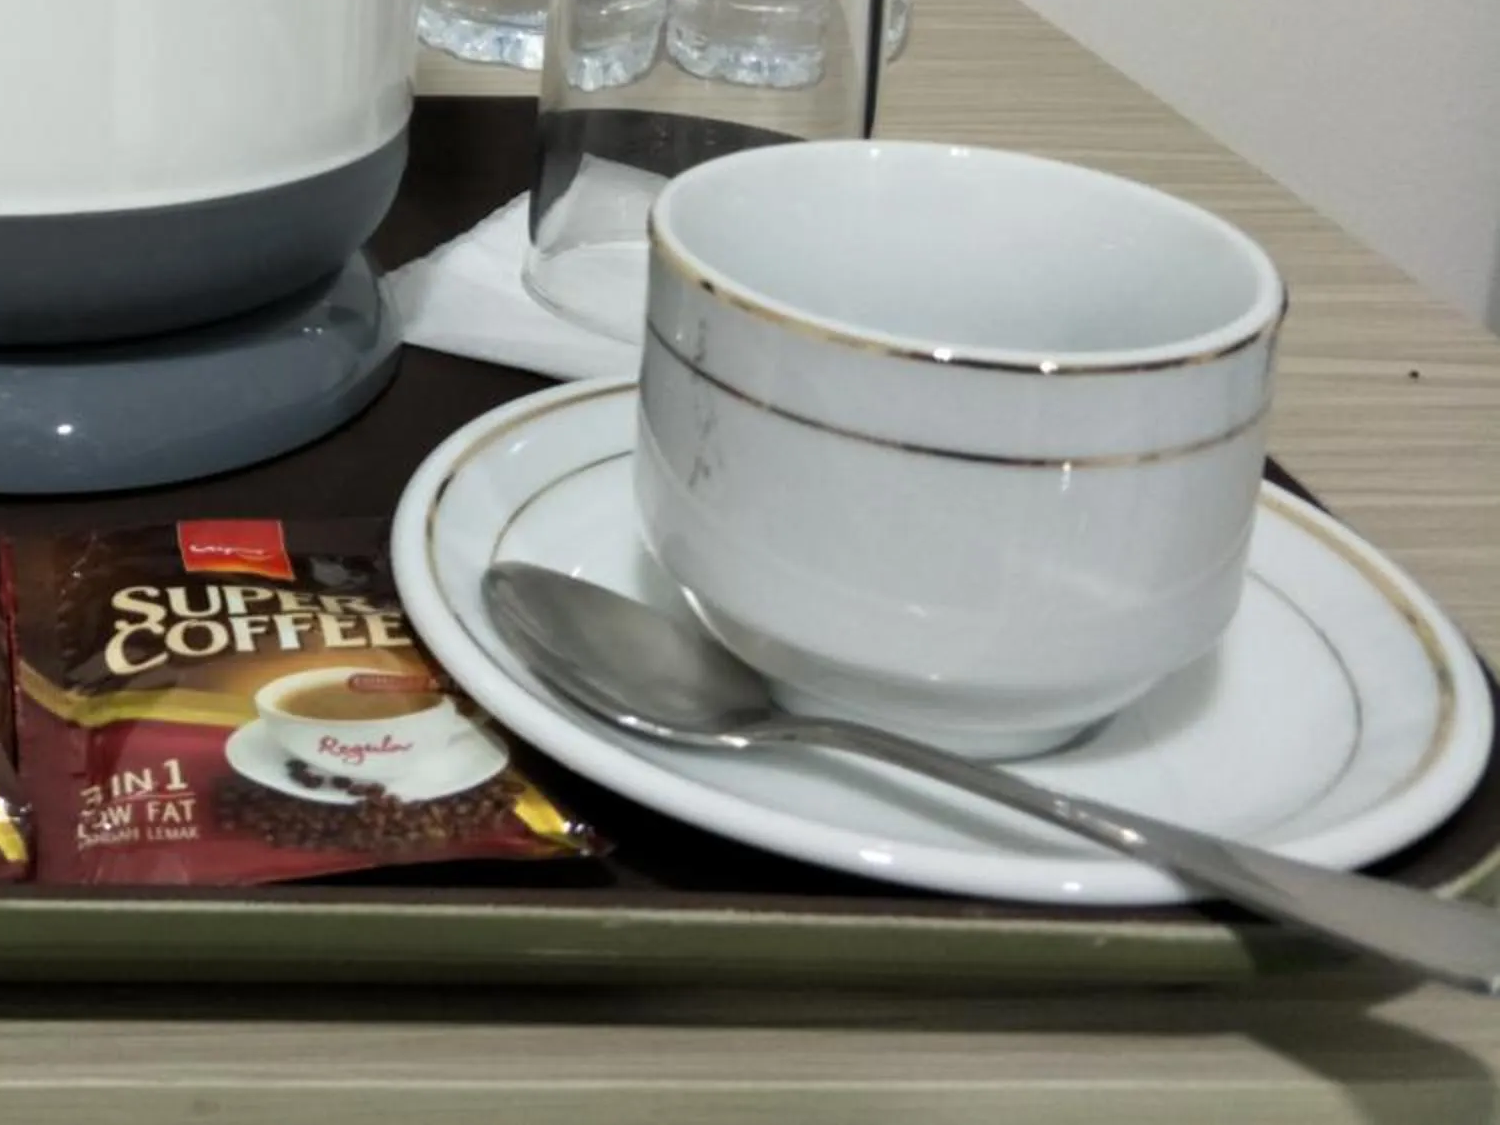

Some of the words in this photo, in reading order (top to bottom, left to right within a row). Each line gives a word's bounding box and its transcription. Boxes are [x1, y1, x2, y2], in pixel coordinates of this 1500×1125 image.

[111, 585, 376, 627] SUPER
[105, 612, 412, 675] COFFEE
[110, 767, 153, 796] IN
[163, 758, 189, 791] 1
[145, 798, 196, 823] FAT
